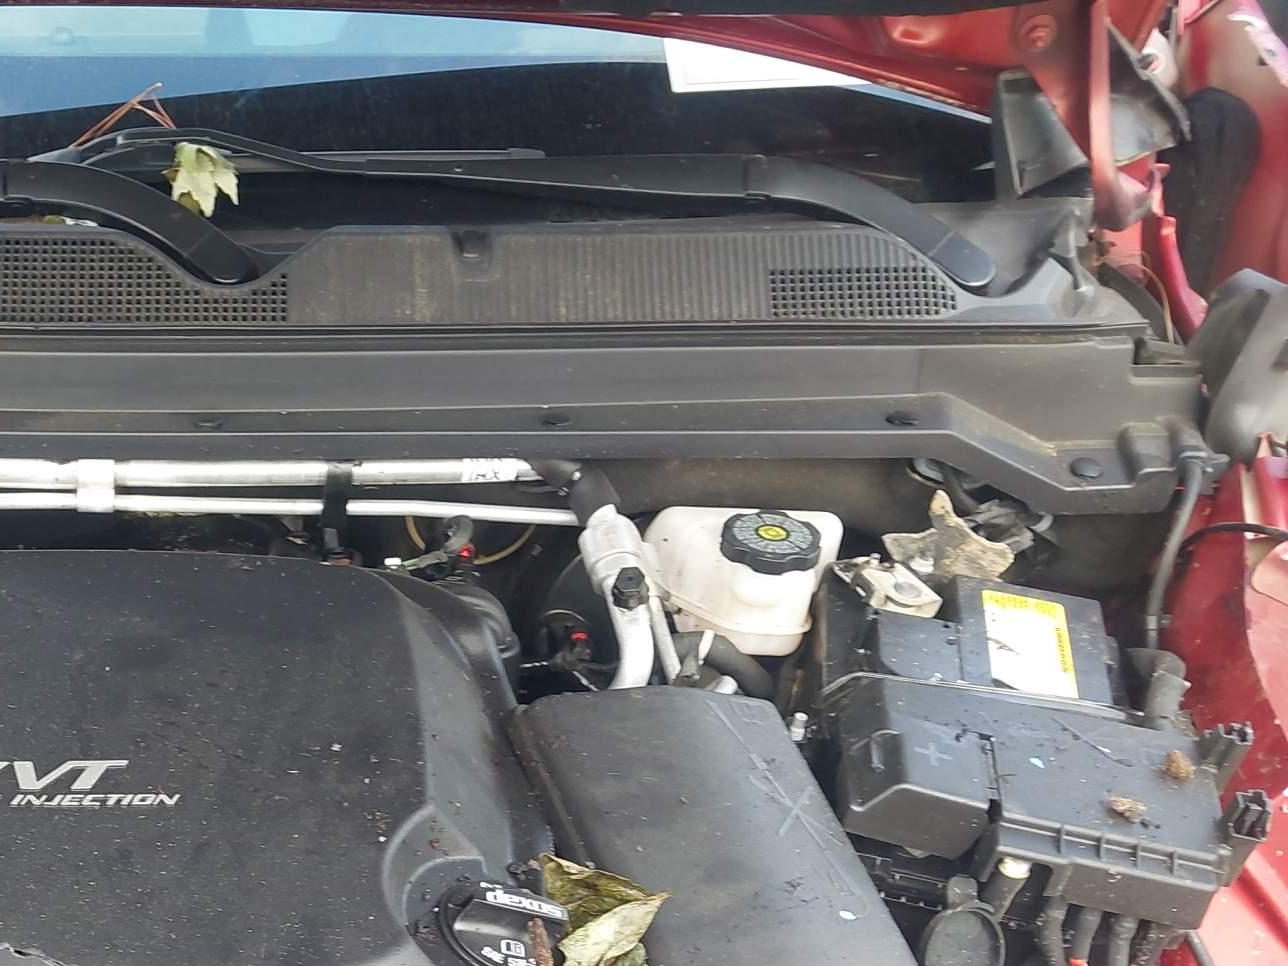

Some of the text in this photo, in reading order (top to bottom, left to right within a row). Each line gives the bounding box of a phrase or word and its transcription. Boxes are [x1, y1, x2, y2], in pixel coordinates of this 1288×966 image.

[9, 793, 181, 808] INJECTION
[485, 889, 563, 918] dexos
[480, 946, 506, 964] SAE
